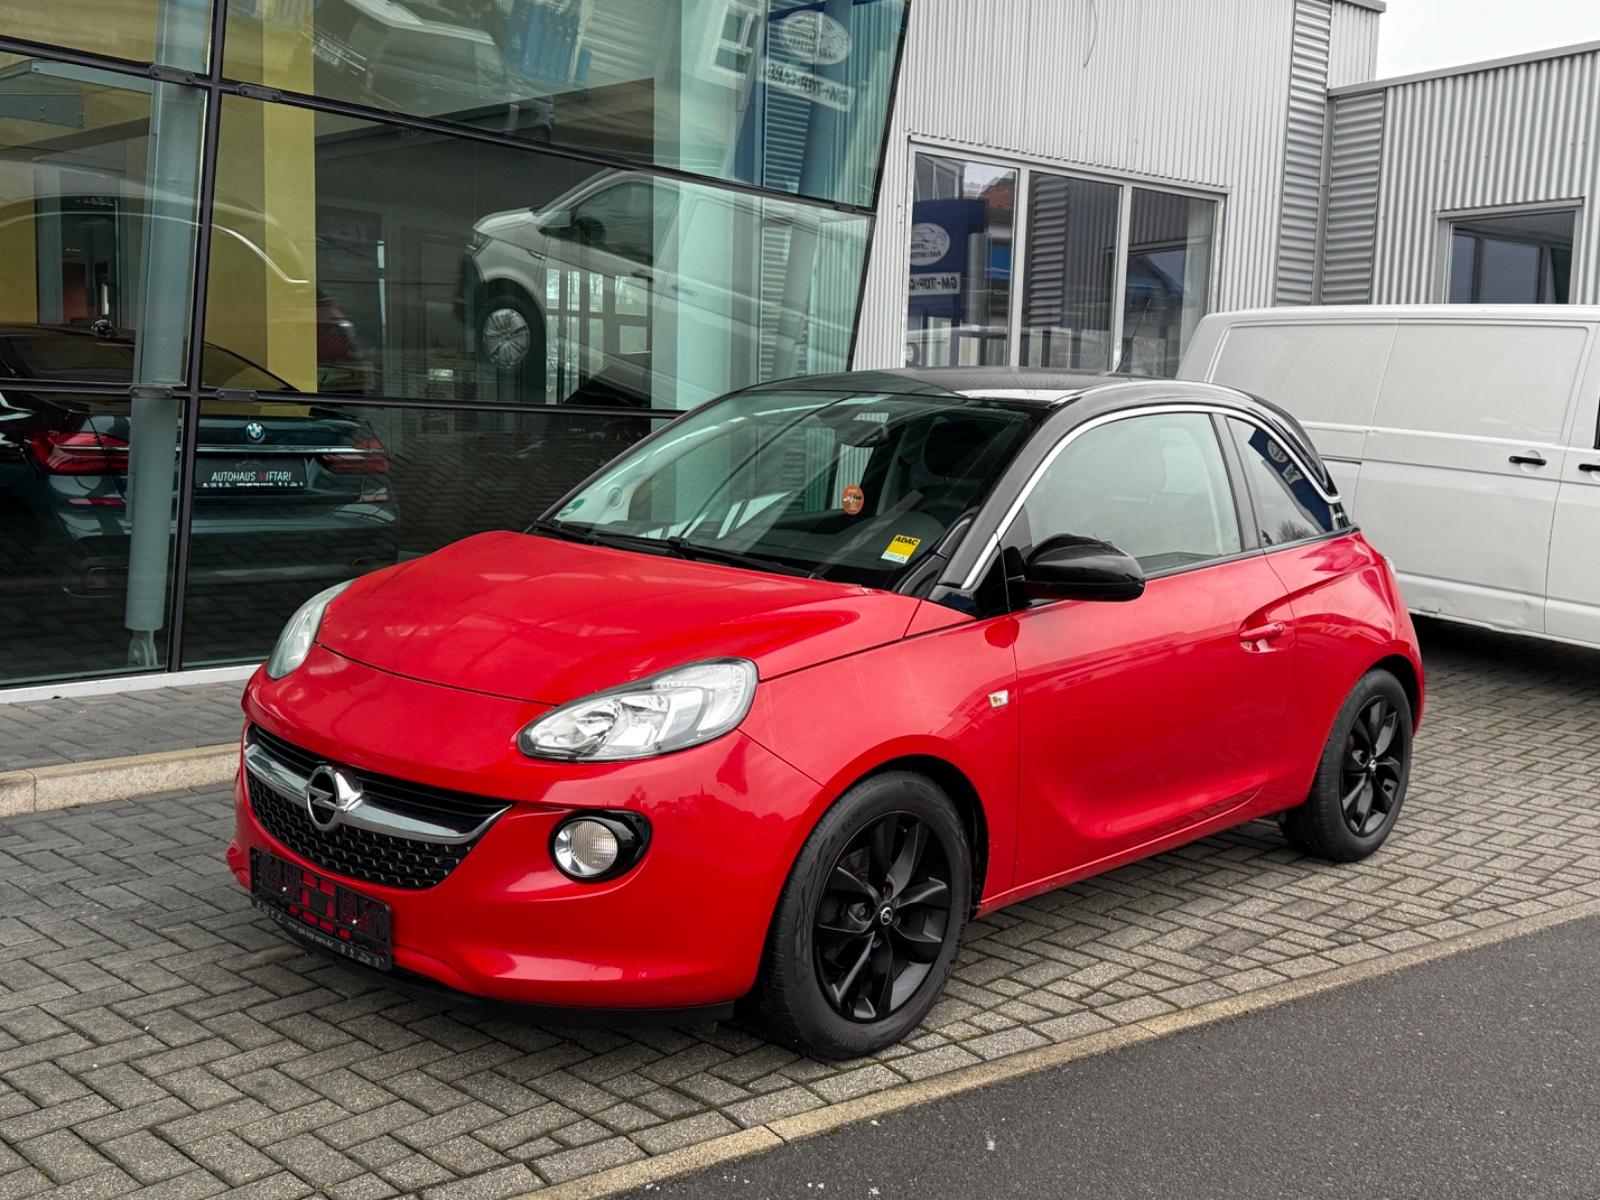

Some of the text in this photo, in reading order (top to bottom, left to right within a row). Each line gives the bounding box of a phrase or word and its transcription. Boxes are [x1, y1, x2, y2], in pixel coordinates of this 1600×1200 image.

[211, 471, 292, 481] AUTOHAUS MIFTARI
[895, 536, 918, 546] ADAC
